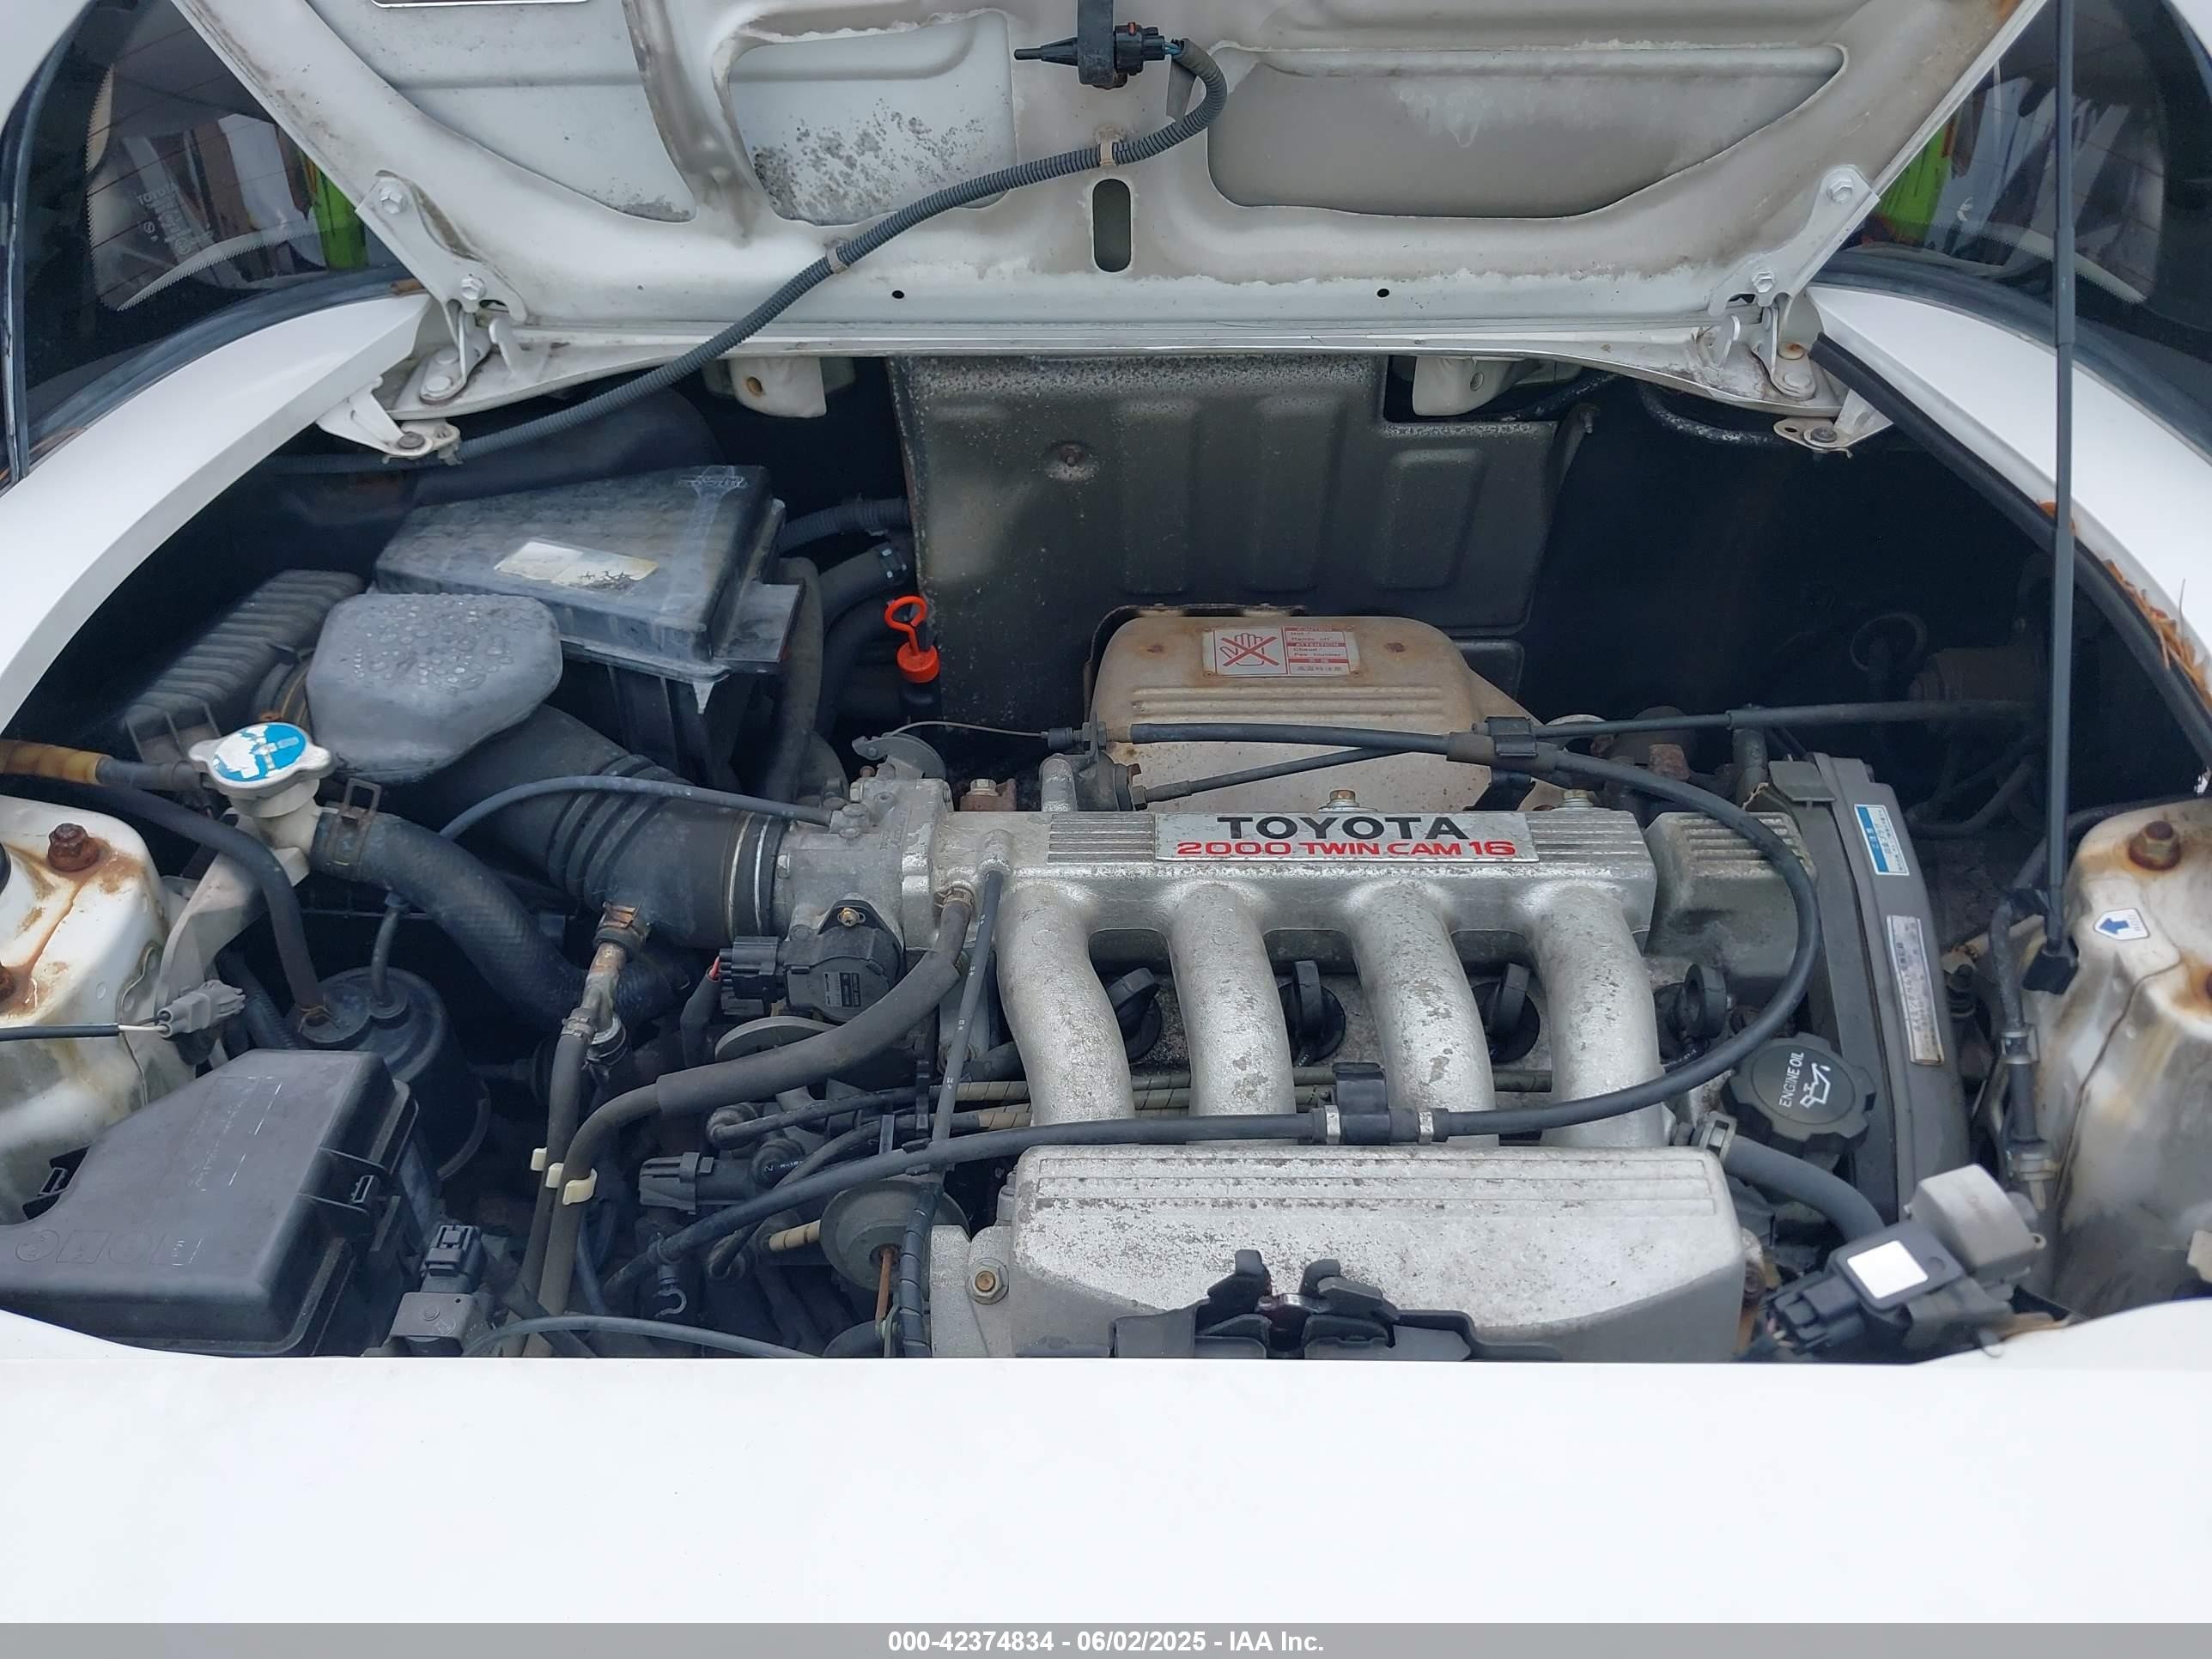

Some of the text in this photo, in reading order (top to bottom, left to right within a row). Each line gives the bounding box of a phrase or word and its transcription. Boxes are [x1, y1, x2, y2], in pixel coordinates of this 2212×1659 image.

[1217, 817, 1469, 839] TOYOTA
[1177, 842, 1516, 855] 2000 TWIN CAM 16
[1779, 1052, 1804, 1108] ENGINE OIL
